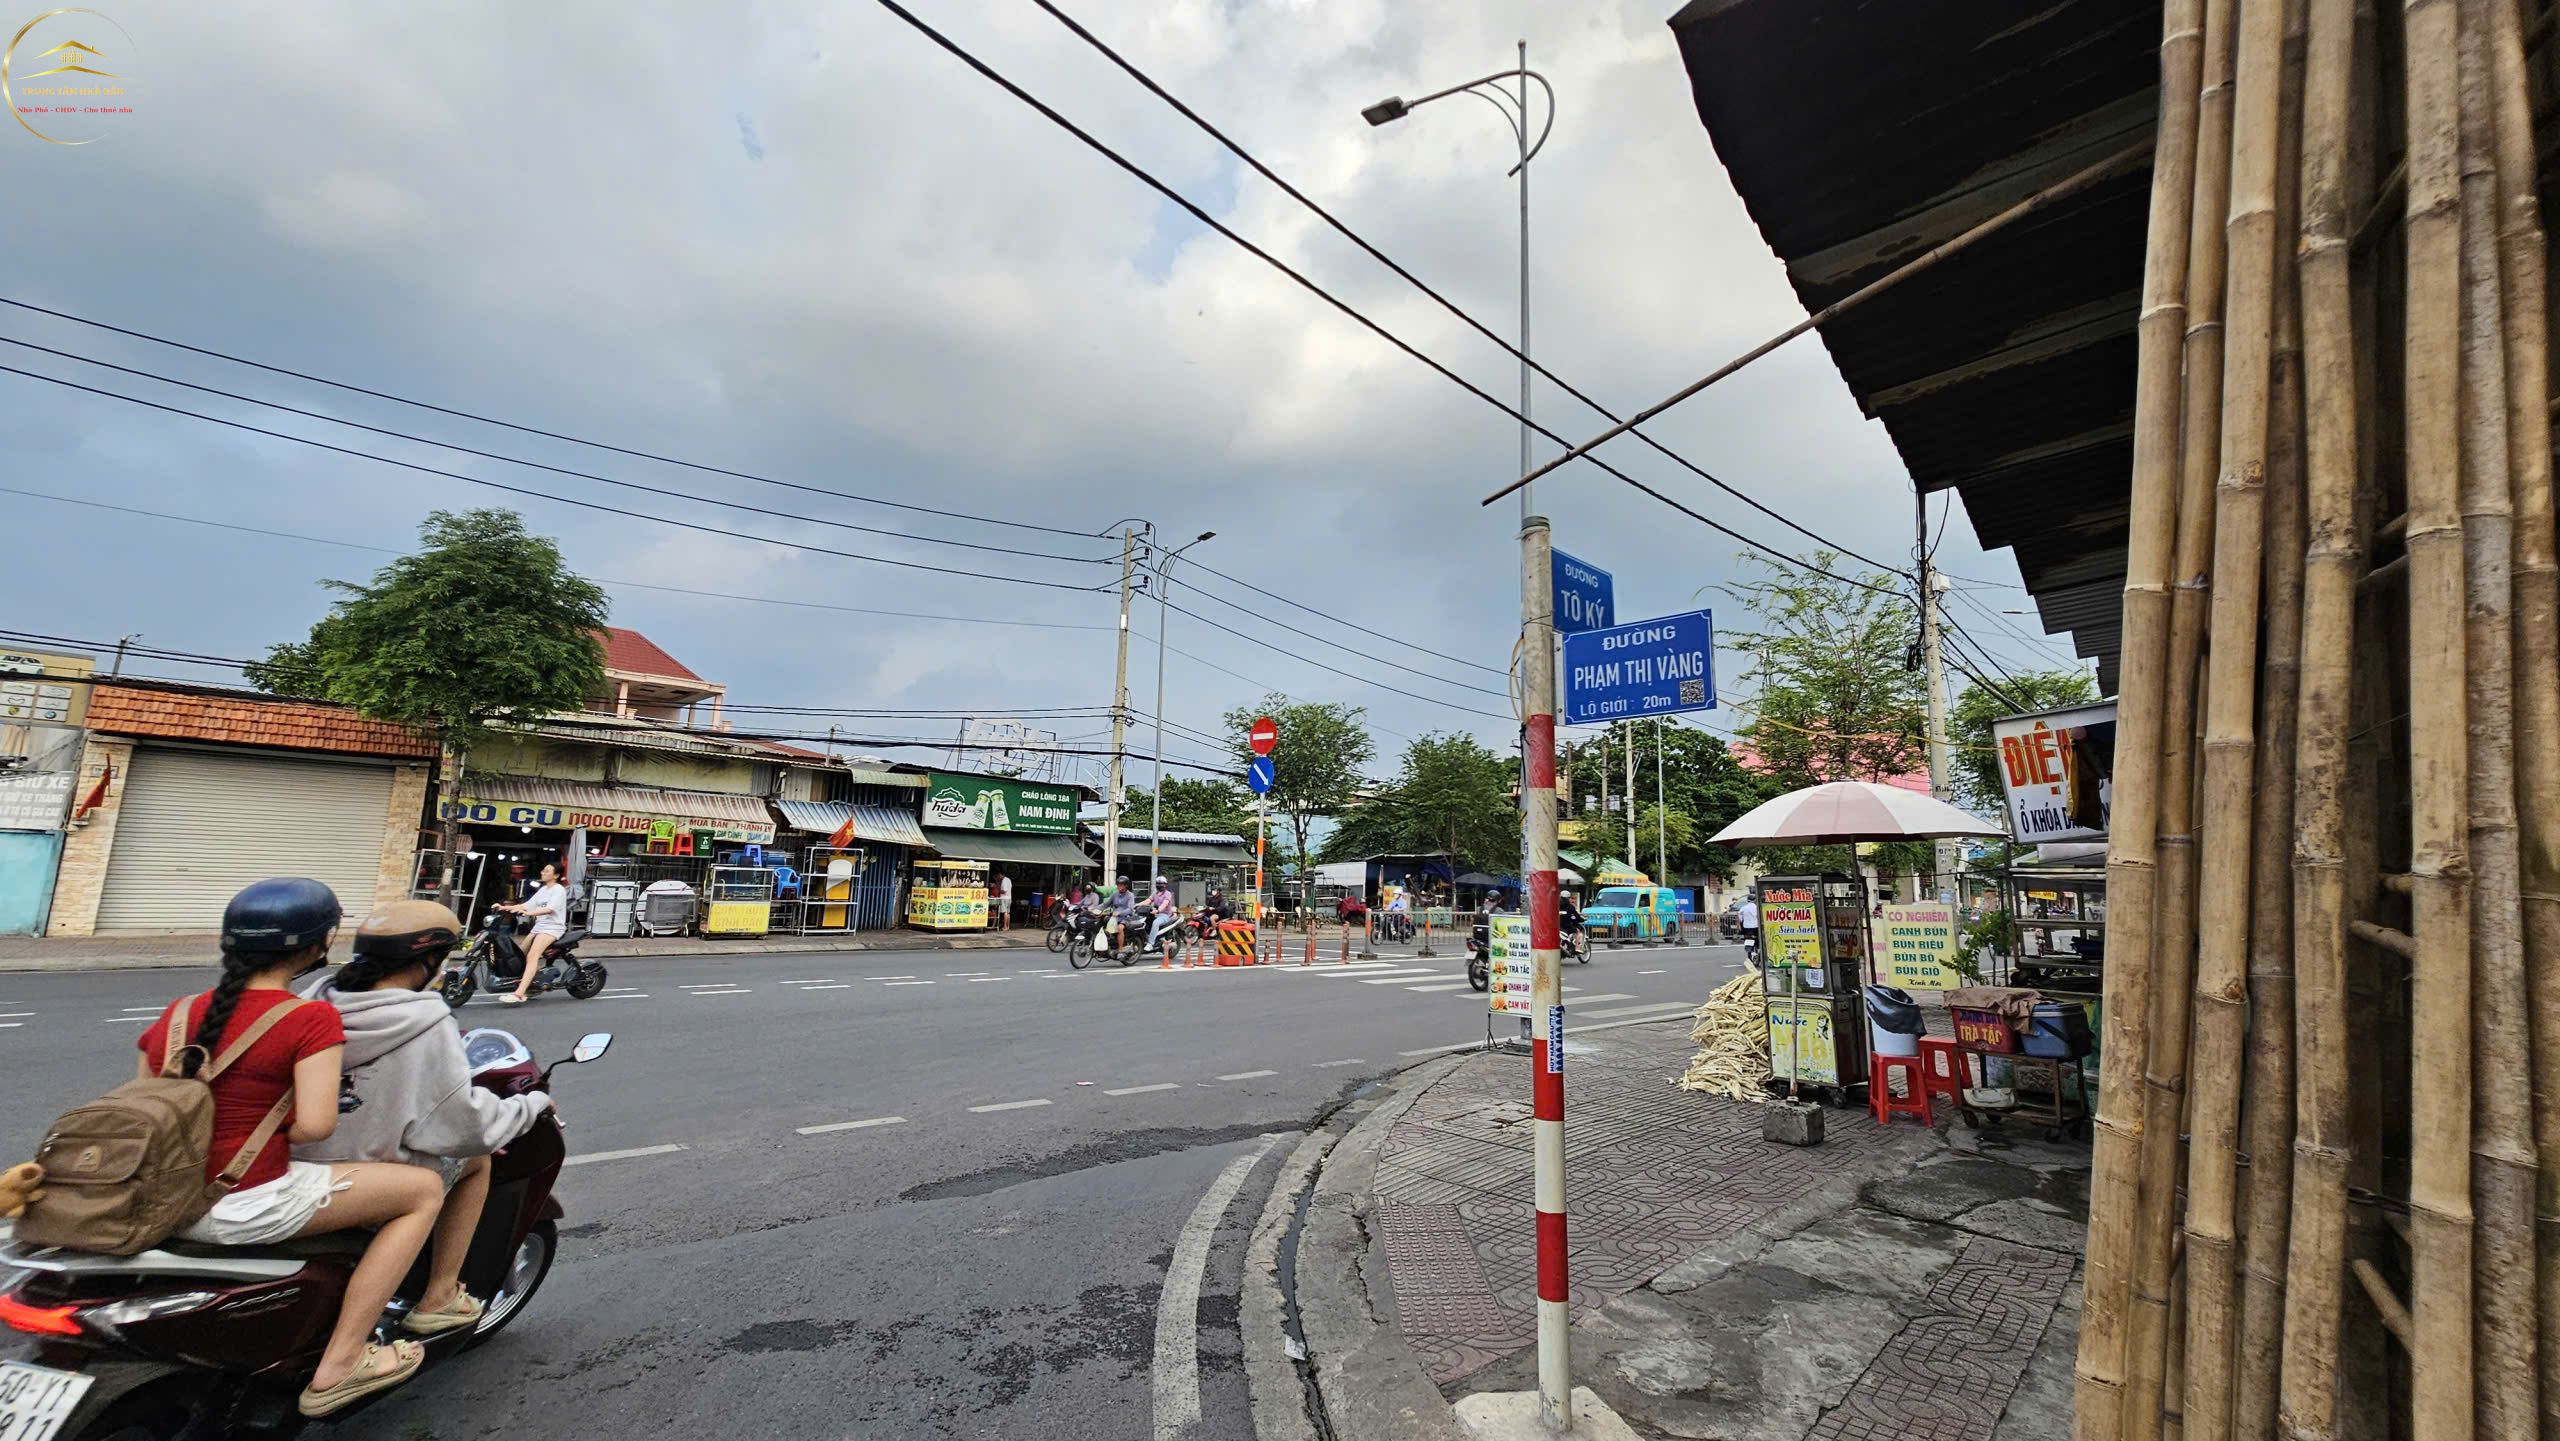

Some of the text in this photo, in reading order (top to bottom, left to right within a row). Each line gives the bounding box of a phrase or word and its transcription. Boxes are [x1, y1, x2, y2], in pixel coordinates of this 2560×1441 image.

[1565, 563, 1599, 588] ĐƯỜNG
[1561, 590, 1605, 628] TÔ KÝ
[1602, 625, 1676, 650] ĐƯỜNG
[1574, 648, 1704, 692] PHẠM THỊ VÀNG
[1580, 700, 1596, 718] LỘ
[1601, 696, 1628, 714] GIỚI
[1643, 694, 1672, 709] 20m
[46, 776, 70, 788] XE
[1022, 790, 1040, 800] CHÁO
[1040, 792, 1057, 802] LÒNG
[1019, 804, 1043, 818] NAM
[1045, 807, 1070, 822] ĐỊNH
[2020, 799, 2030, 834] Ổ
[2030, 802, 2062, 832] KHÓA
[1766, 905, 1792, 921] NƯỚC
[1794, 904, 1812, 921] MÍA
[1892, 926, 1948, 936] CANH BÚN
[1893, 939, 1915, 949] BÚN
[1894, 952, 1916, 962] BÚN
[1896, 965, 1918, 975] BÚN
